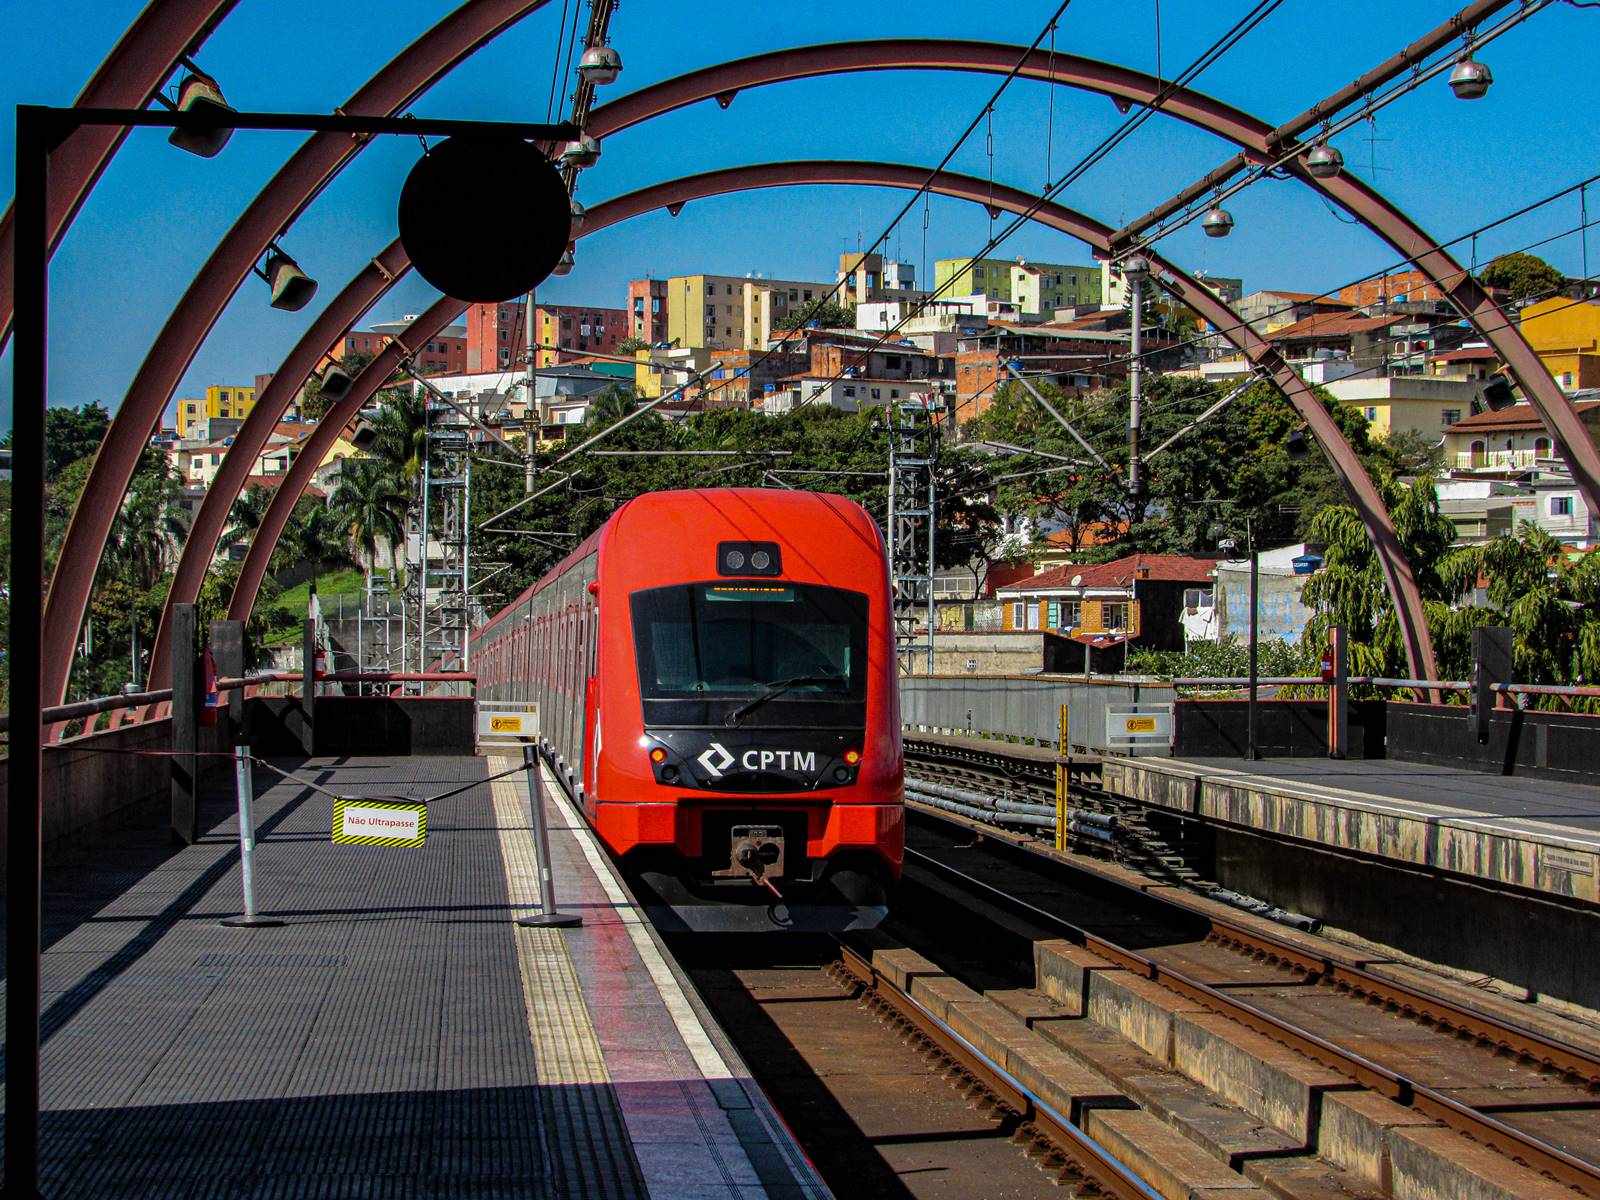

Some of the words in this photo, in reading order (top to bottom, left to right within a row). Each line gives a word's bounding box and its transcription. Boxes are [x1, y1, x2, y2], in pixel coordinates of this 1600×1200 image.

[742, 750, 816, 771] CPTM
[348, 816, 366, 825] Não
[368, 817, 415, 828] Ultrapasse
